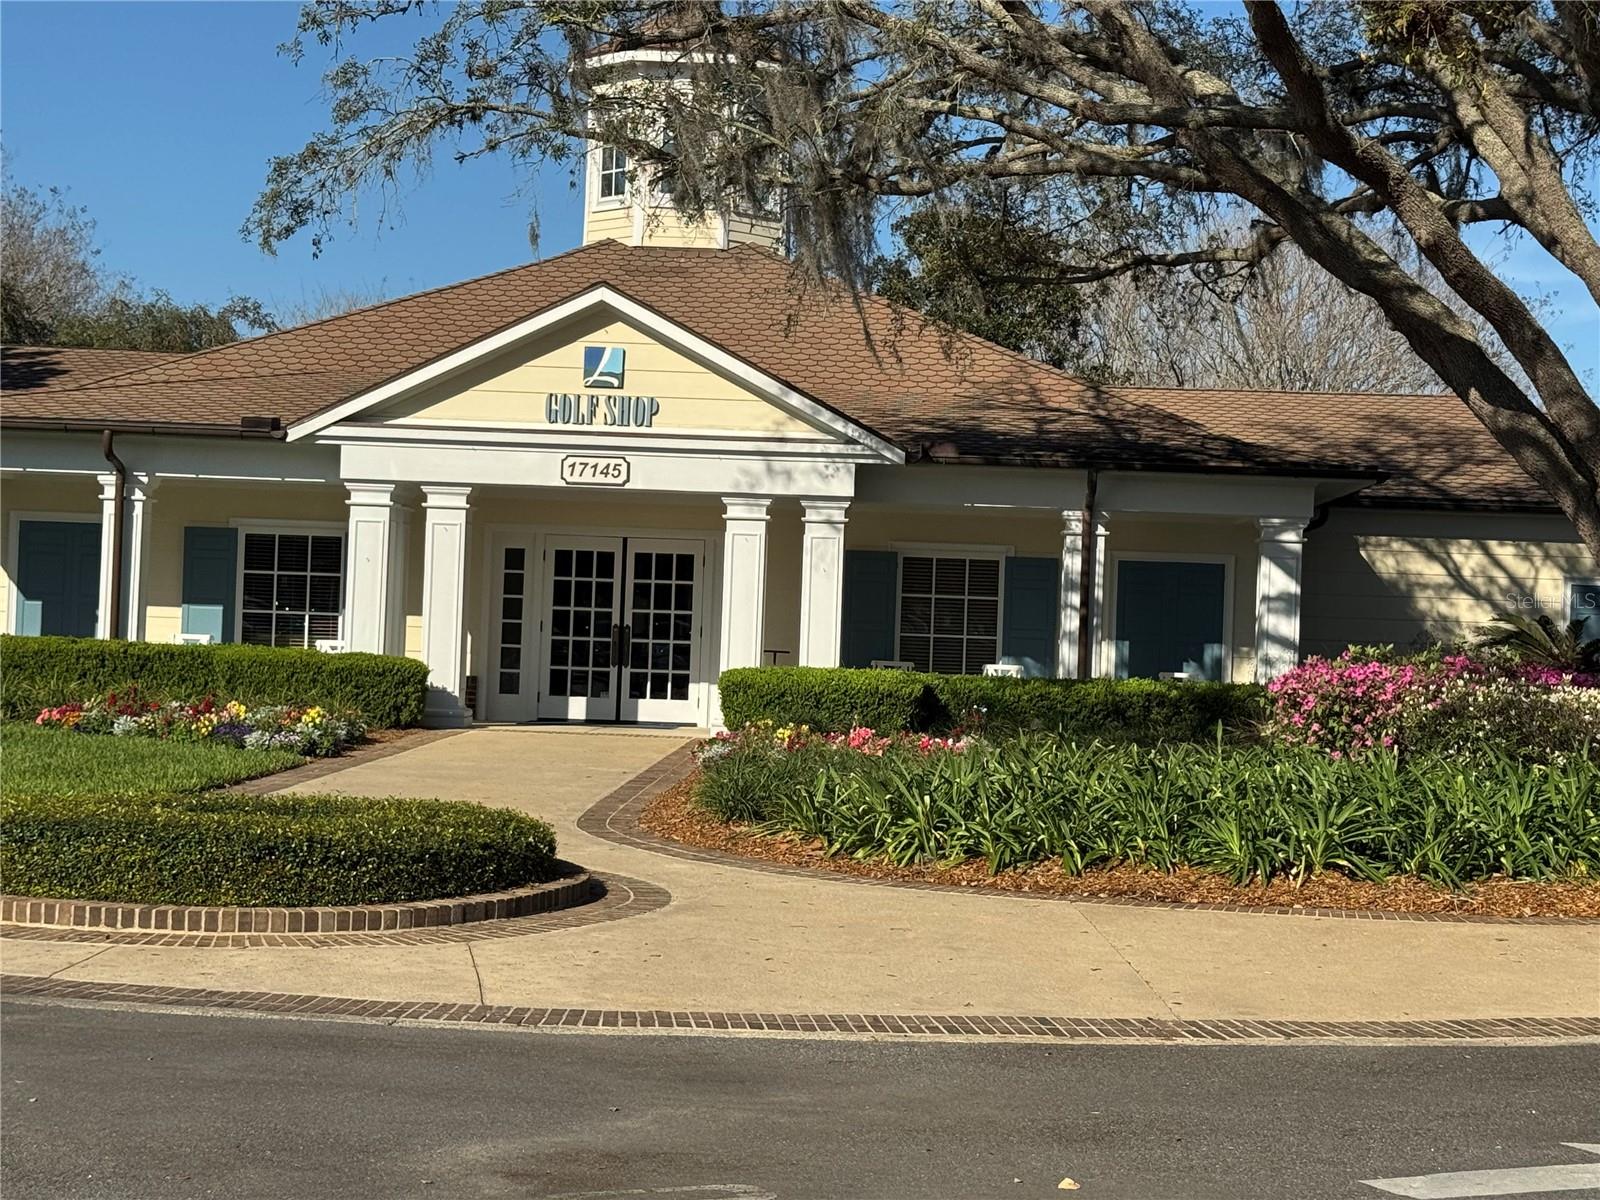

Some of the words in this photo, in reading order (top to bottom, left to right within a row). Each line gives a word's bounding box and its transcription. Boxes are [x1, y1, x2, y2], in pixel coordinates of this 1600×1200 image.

[545, 392, 599, 426] GOLF
[603, 394, 660, 427] SHOP
[567, 461, 623, 479] 17145
